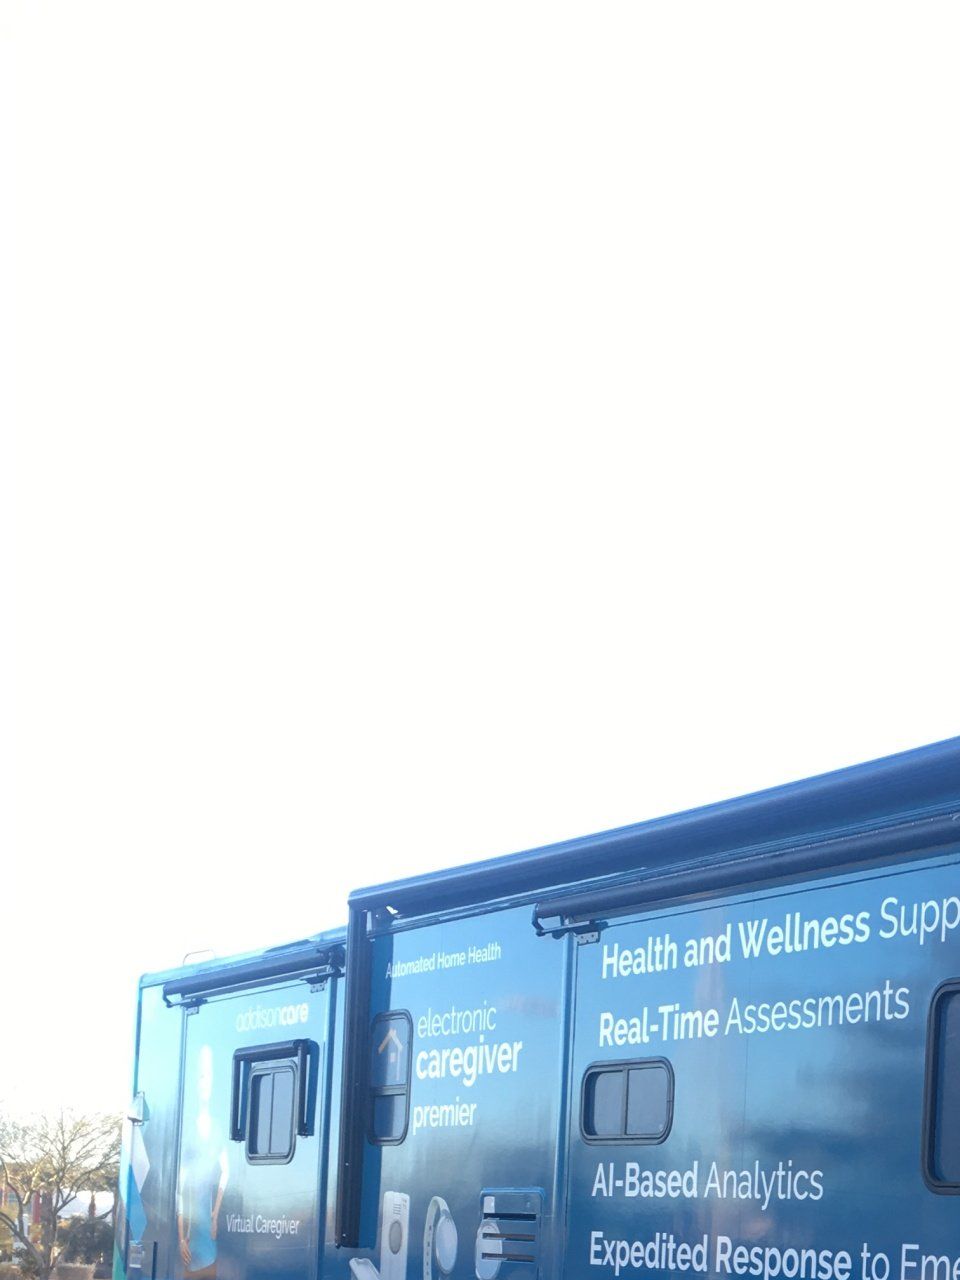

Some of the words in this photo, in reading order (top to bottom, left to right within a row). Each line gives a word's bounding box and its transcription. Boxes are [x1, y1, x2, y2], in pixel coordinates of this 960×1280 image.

[385, 952, 435, 980] Automated
[437, 951, 466, 969] Home
[467, 941, 502, 965] Health
[601, 933, 677, 979] Health
[684, 923, 731, 967] and
[738, 911, 870, 960] Wellness
[417, 1000, 497, 1038] electronic
[599, 1003, 720, 1047] Real-Time
[724, 979, 911, 1036] Assessments
[415, 1034, 523, 1087] caregiver
[412, 1096, 477, 1136] premier
[591, 1160, 698, 1198] AI-Based
[704, 1159, 824, 1210] Analytics
[226, 1214, 254, 1233] Virtual
[255, 1214, 300, 1240] Caregiver
[589, 1230, 708, 1277] Expedited
